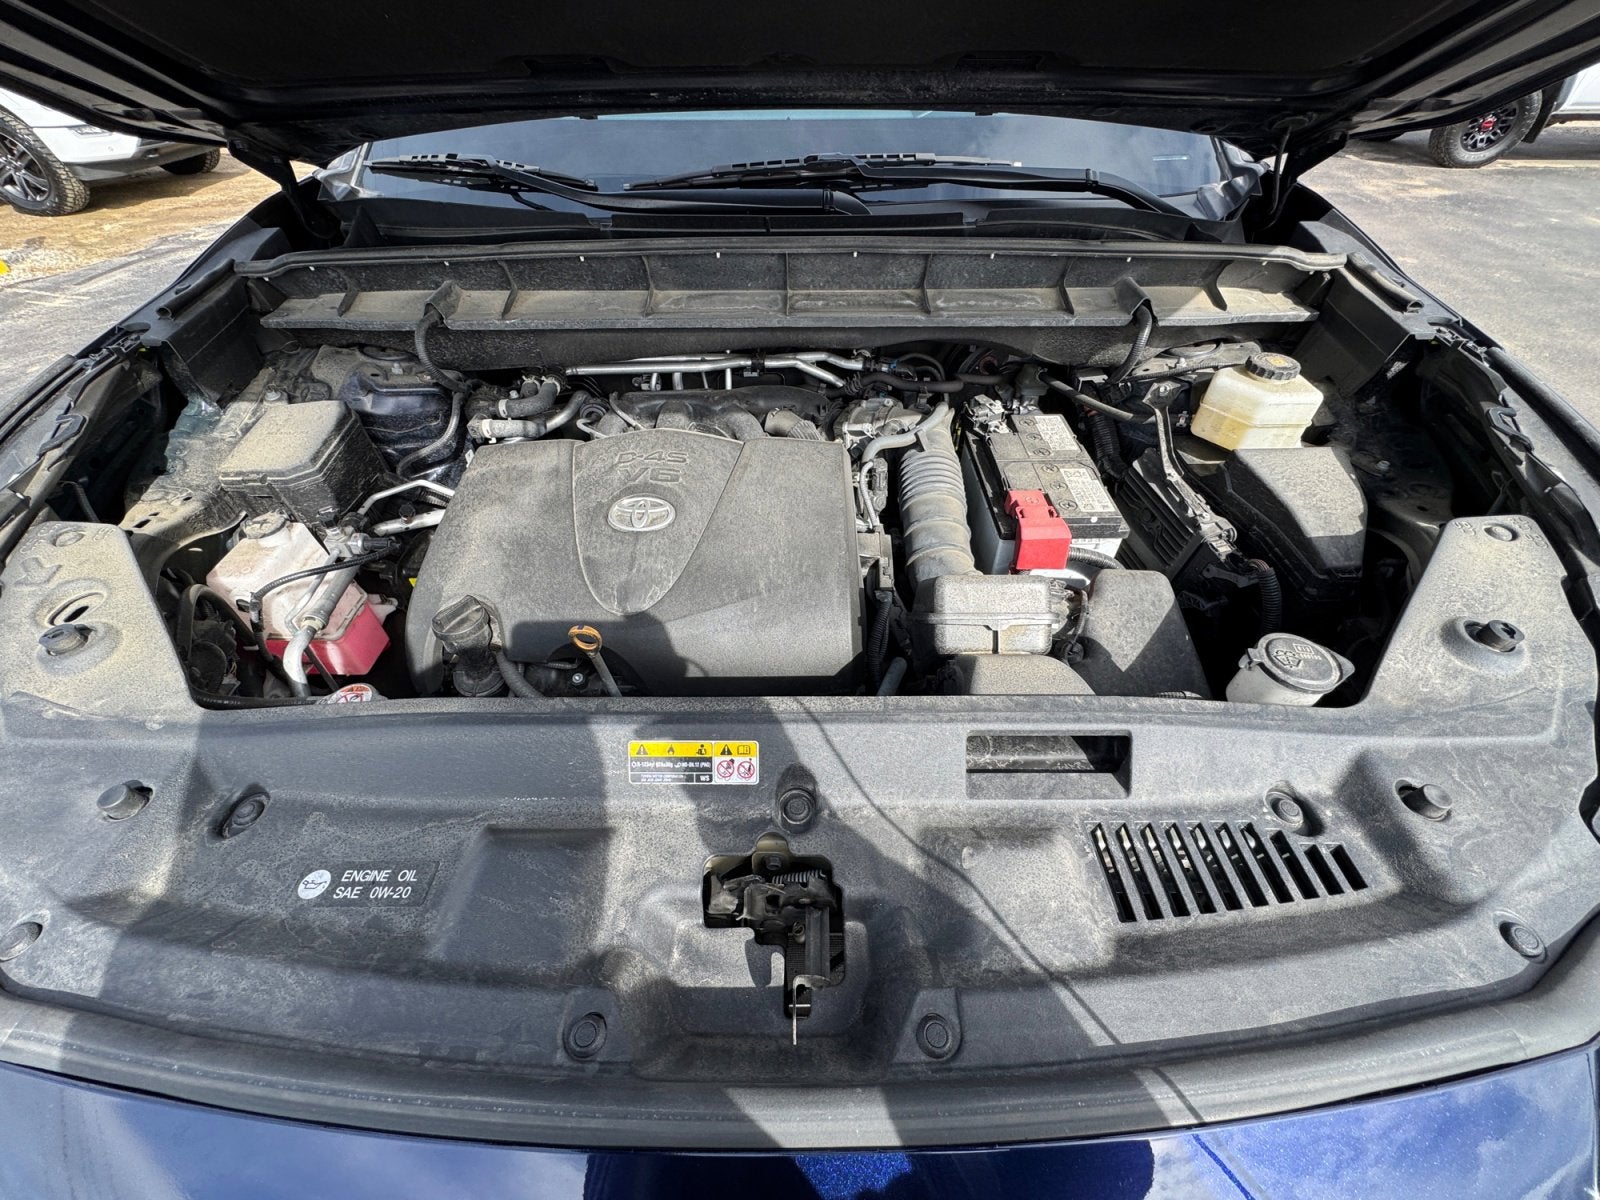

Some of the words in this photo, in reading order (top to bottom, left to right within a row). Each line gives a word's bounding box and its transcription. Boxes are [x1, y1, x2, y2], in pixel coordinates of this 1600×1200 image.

[617, 466, 682, 483] V6
[341, 869, 392, 882] ENGINE
[397, 869, 418, 882] OIL
[333, 886, 363, 899] SAE
[369, 886, 412, 899] 0W-20
